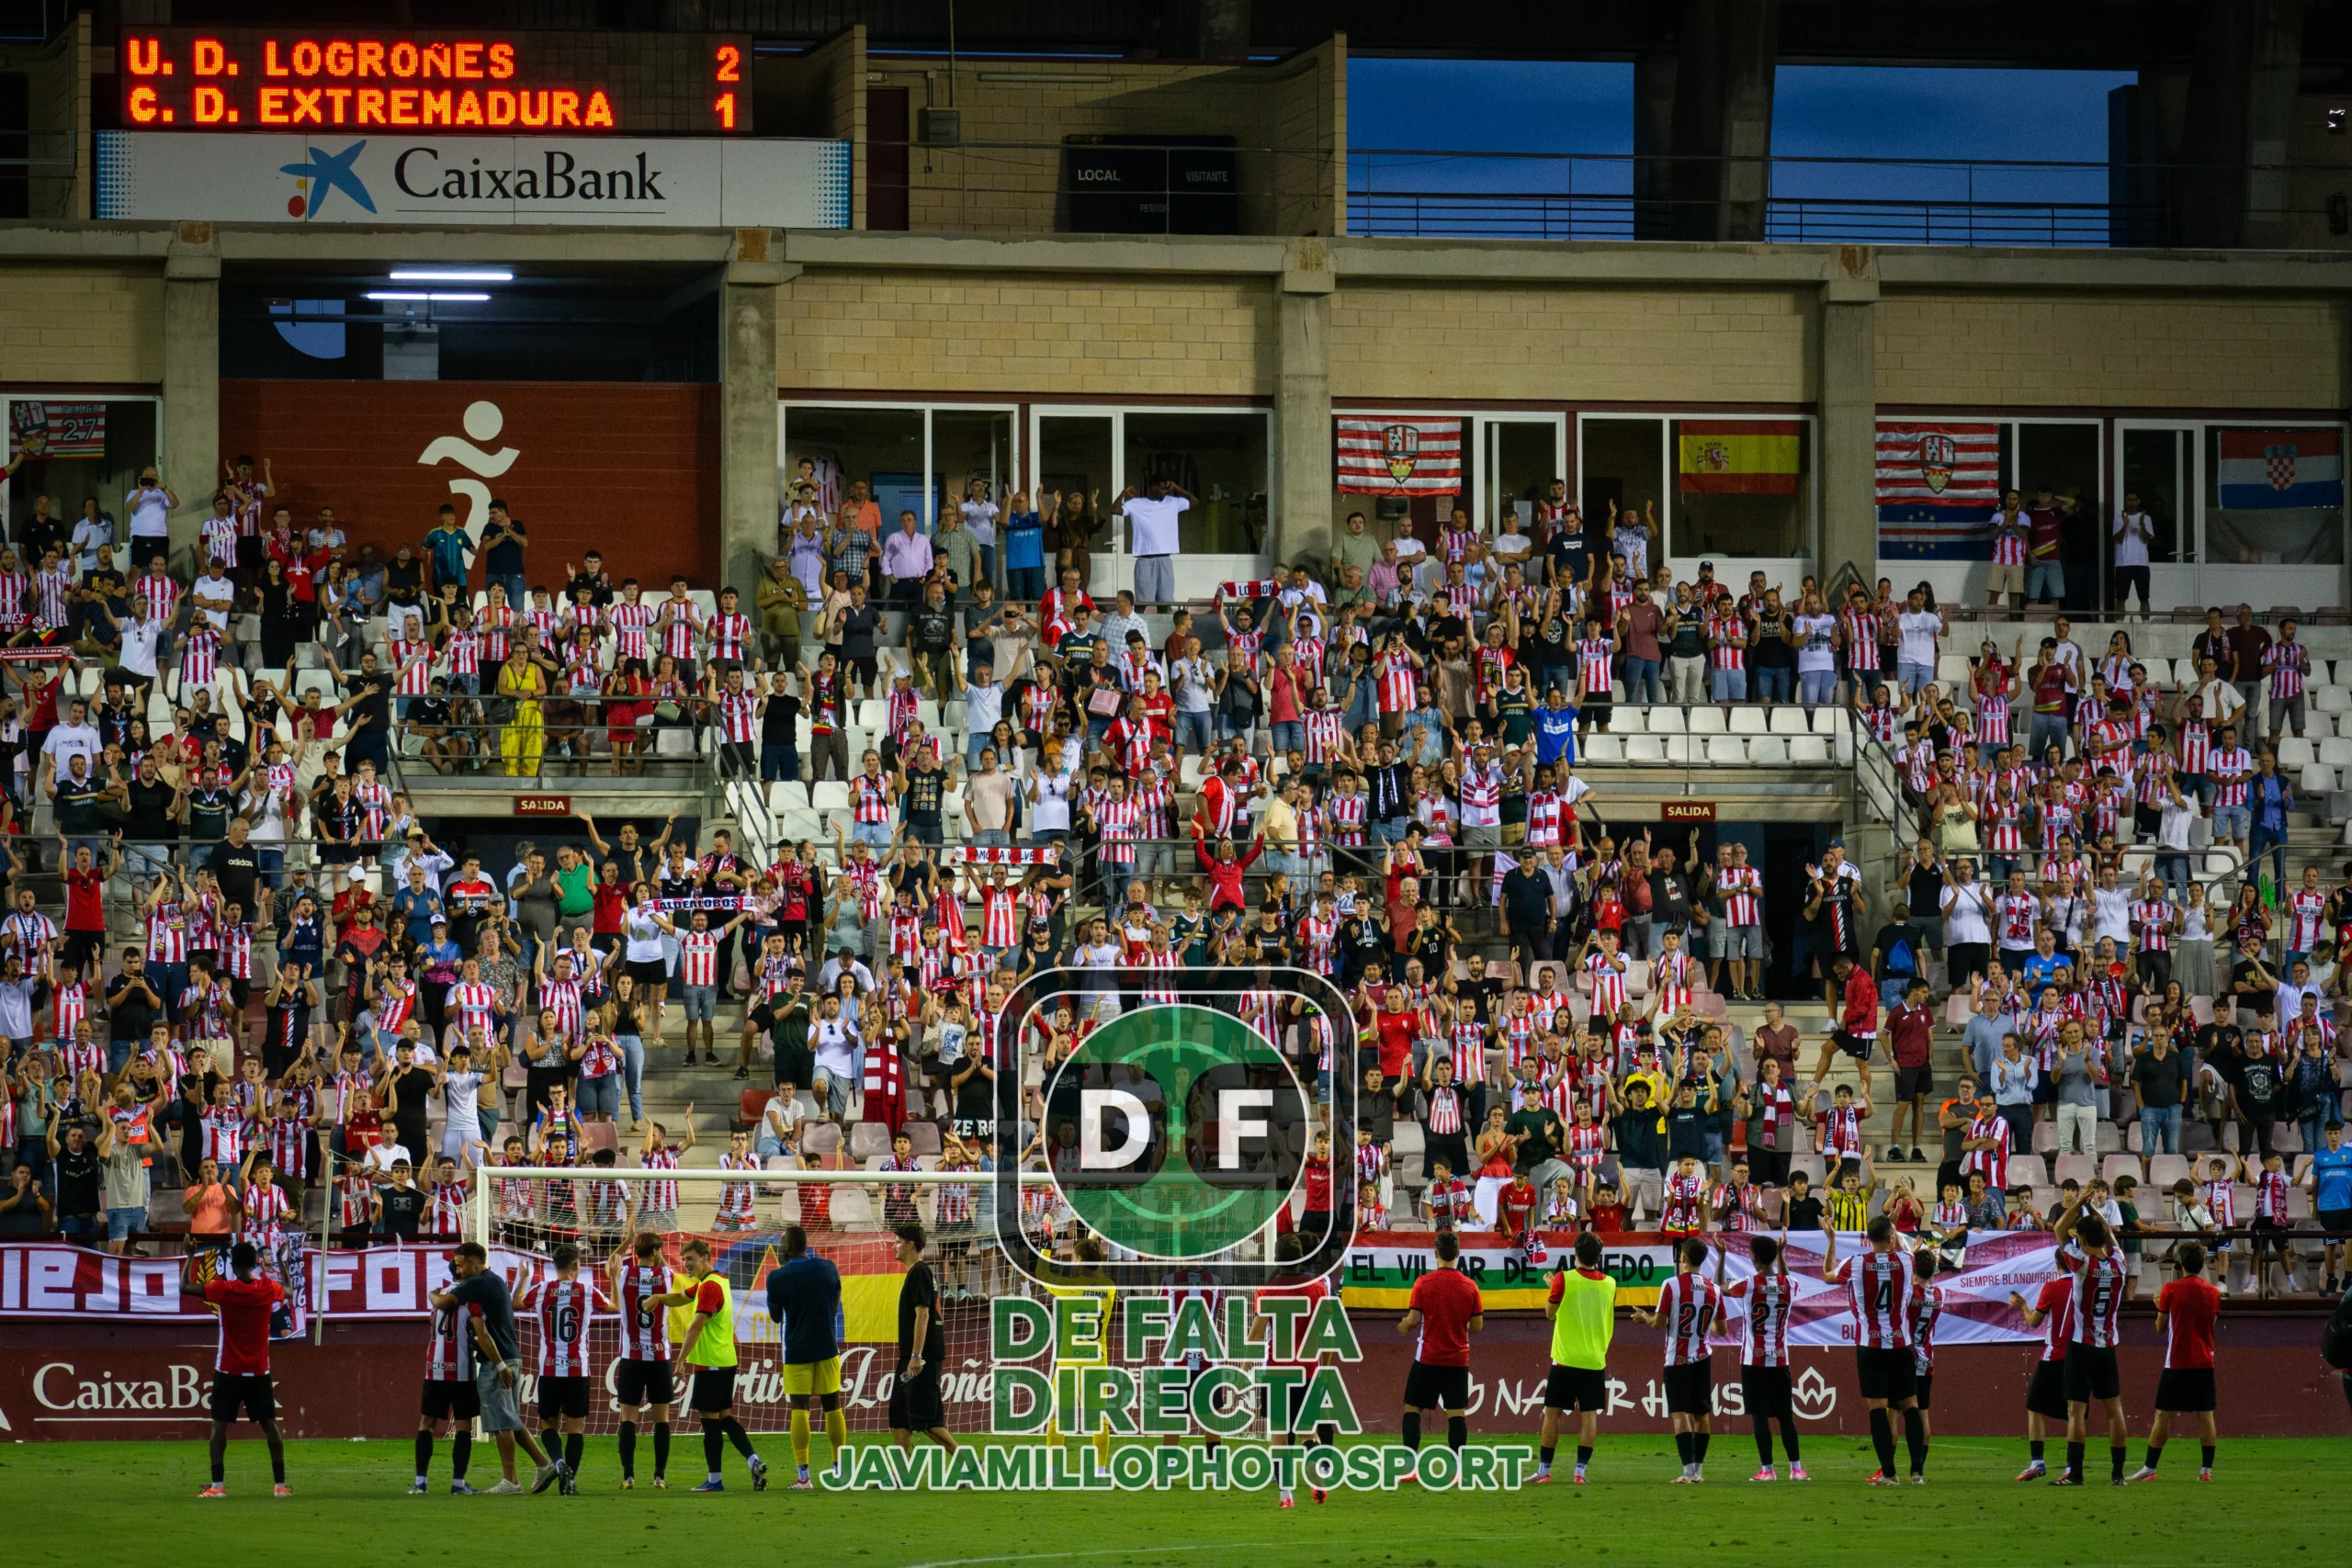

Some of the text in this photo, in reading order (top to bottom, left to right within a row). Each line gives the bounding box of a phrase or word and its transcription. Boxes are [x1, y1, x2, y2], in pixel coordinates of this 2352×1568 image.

[130, 39, 514, 79] U. D. LOGROÑES
[717, 47, 740, 82] 2
[130, 87, 613, 127] C. D. EXTREMADURA
[715, 94, 734, 128] 1
[394, 147, 666, 200] CaixaBank
[1077, 169, 1121, 181] LOCAL
[1185, 171, 1228, 183] VISITANTE
[62, 418, 100, 442] 27
[521, 801, 566, 811] SALIDA
[1668, 806, 1712, 817] SALIDA
[228, 858, 254, 867] adidas
[967, 849, 1042, 862] VAMOS A VOLVER
[659, 897, 740, 909] ALDEALOBOS
[1429, 942, 1439, 953] 10
[1351, 1253, 1655, 1283] EL VILAR DE AEDO
[1960, 1270, 2061, 1289] SIEMPRE BLANQUIRRO
[550, 1288, 580, 1298] ZABALA
[1873, 1280, 1894, 1314] 4
[2091, 1286, 2112, 1318] 5
[546, 1304, 580, 1343] 16
[636, 1293, 655, 1329] 8
[1678, 1302, 1715, 1340] 20
[1751, 1302, 1790, 1337] 27
[33, 1362, 283, 1410] CaixaBa
[1493, 1378, 1634, 1417] NAR
